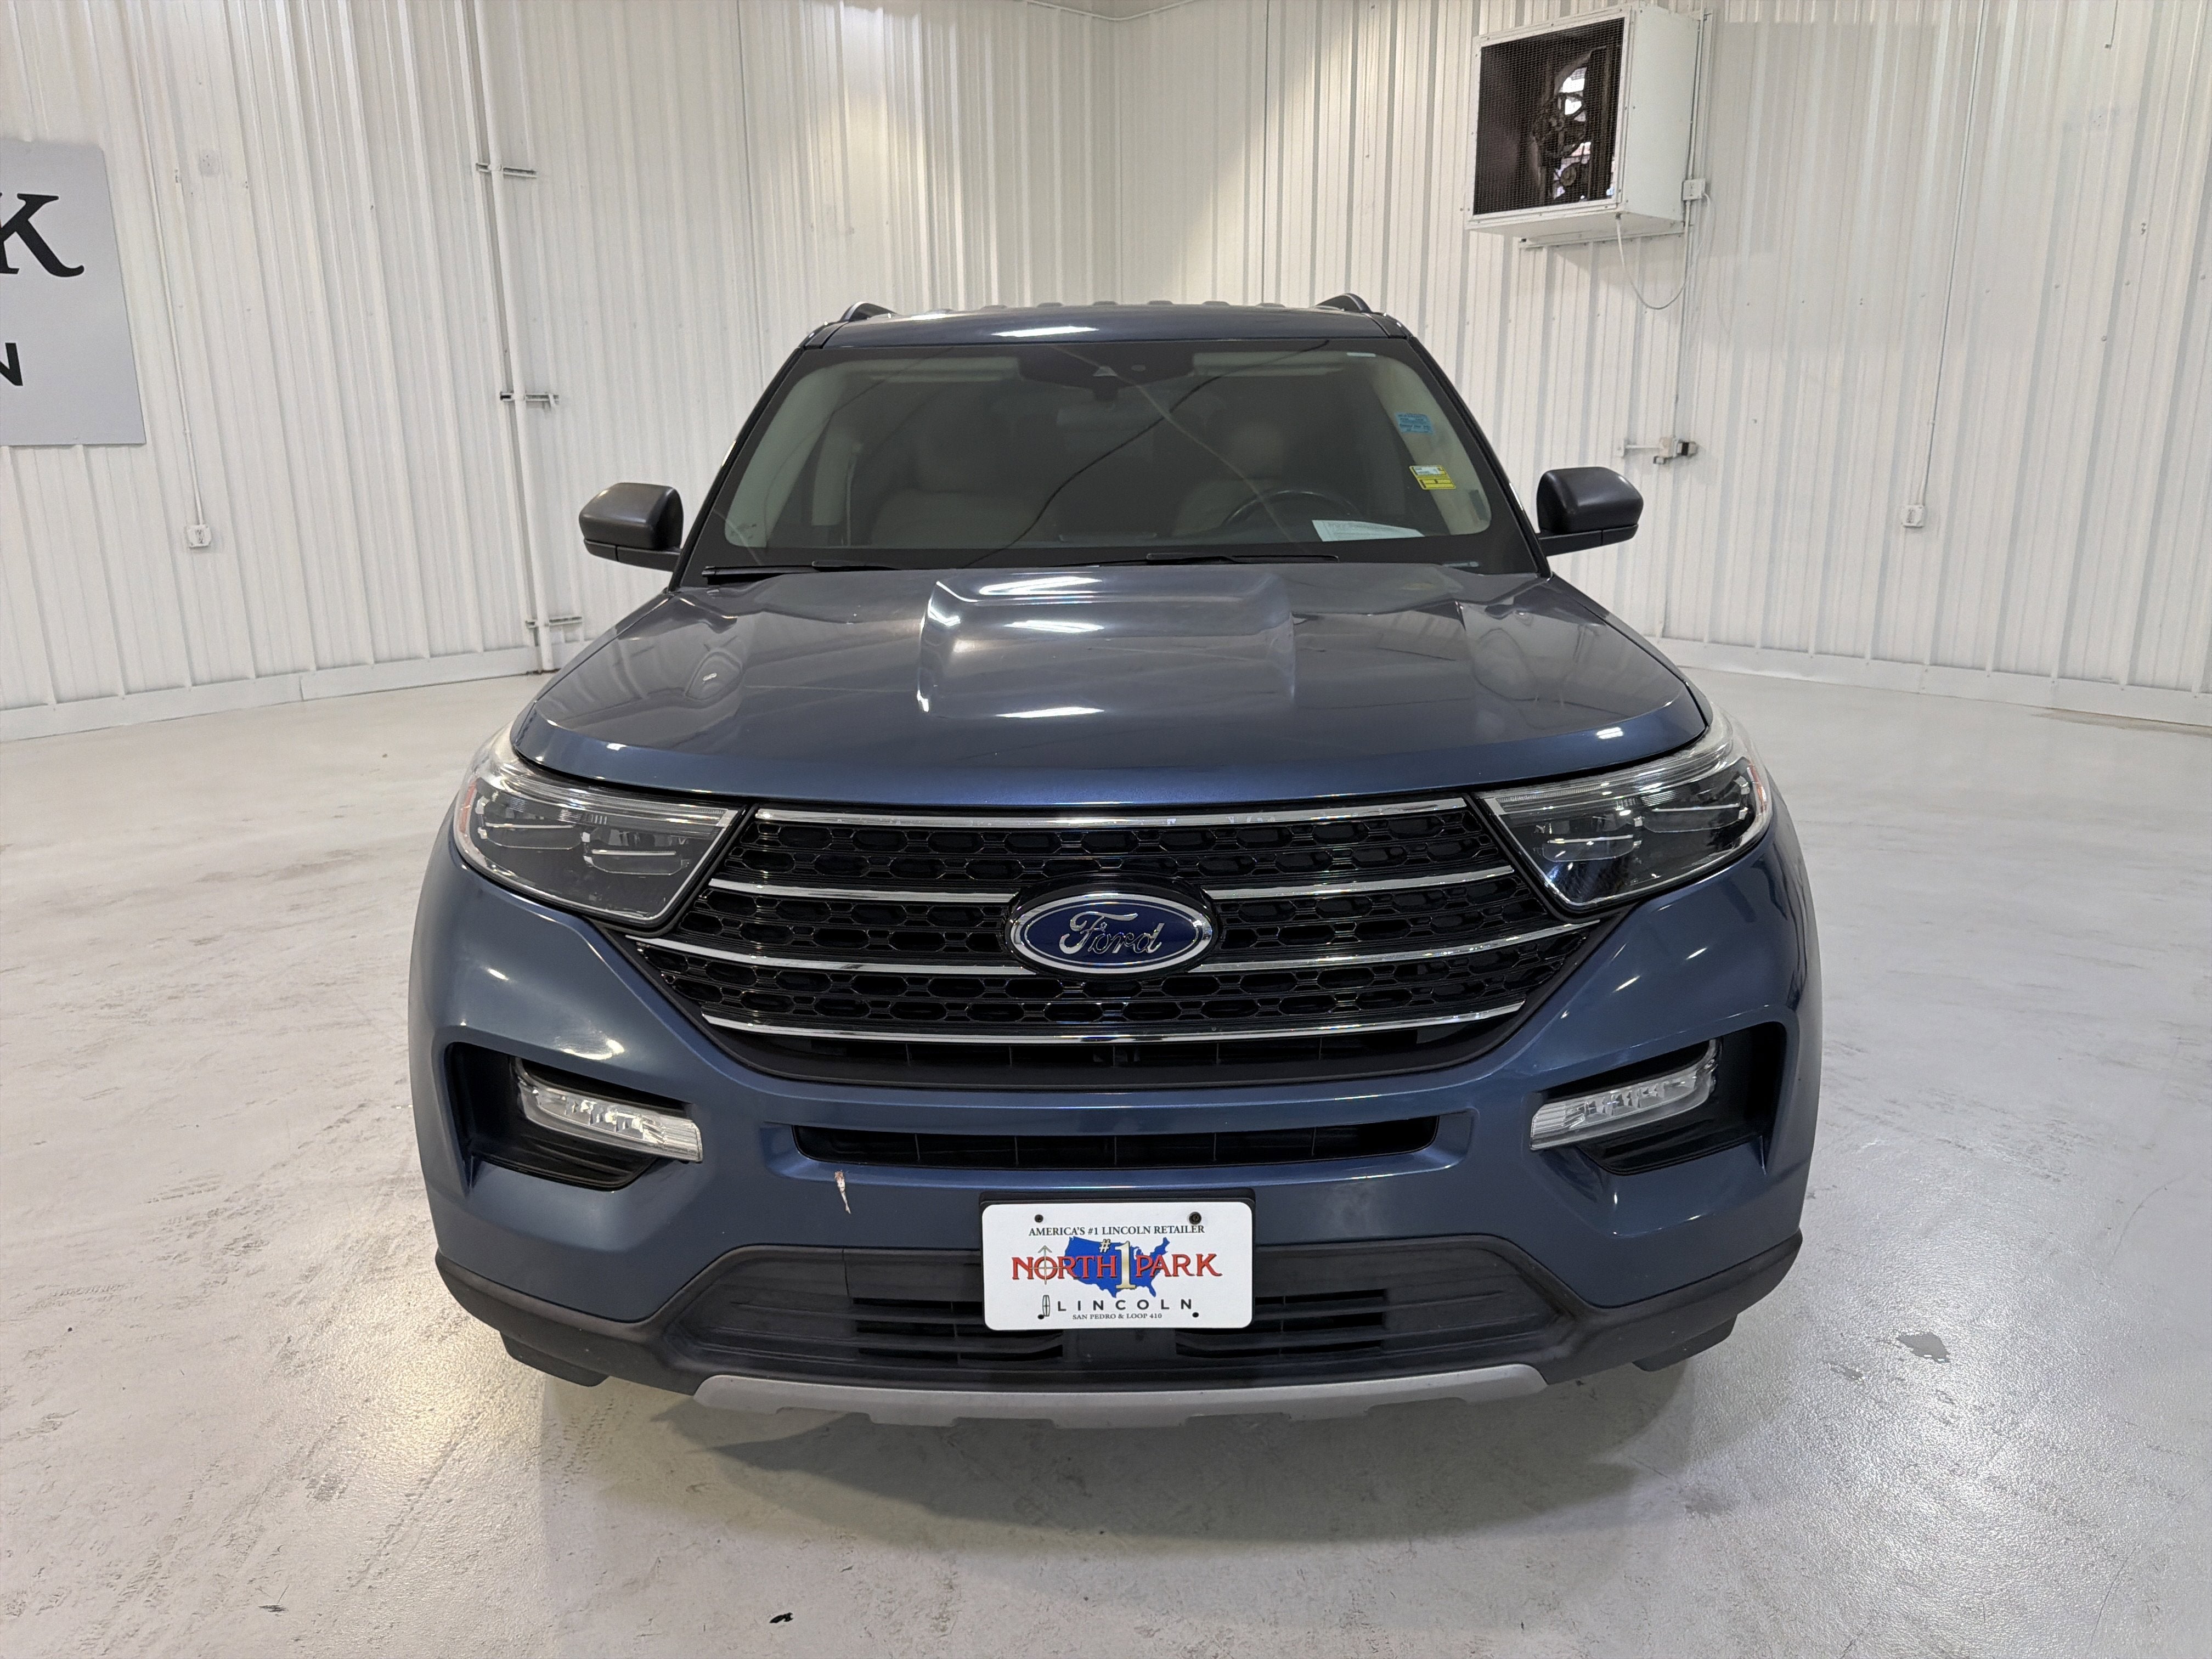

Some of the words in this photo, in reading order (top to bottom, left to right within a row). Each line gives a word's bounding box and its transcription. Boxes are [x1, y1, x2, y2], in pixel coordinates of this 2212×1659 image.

[1059, 911, 1165, 954] Ford
[1029, 1227, 1086, 1236] AMERICA'S
[1087, 1227, 1099, 1235] #1
[1102, 1226, 1152, 1235] LINCOLN
[1154, 1225, 1205, 1234] RETAILER
[1012, 1255, 1118, 1280] NORTH
[1136, 1253, 1223, 1277] PARK
[1057, 1299, 1192, 1312] LINCOLN
